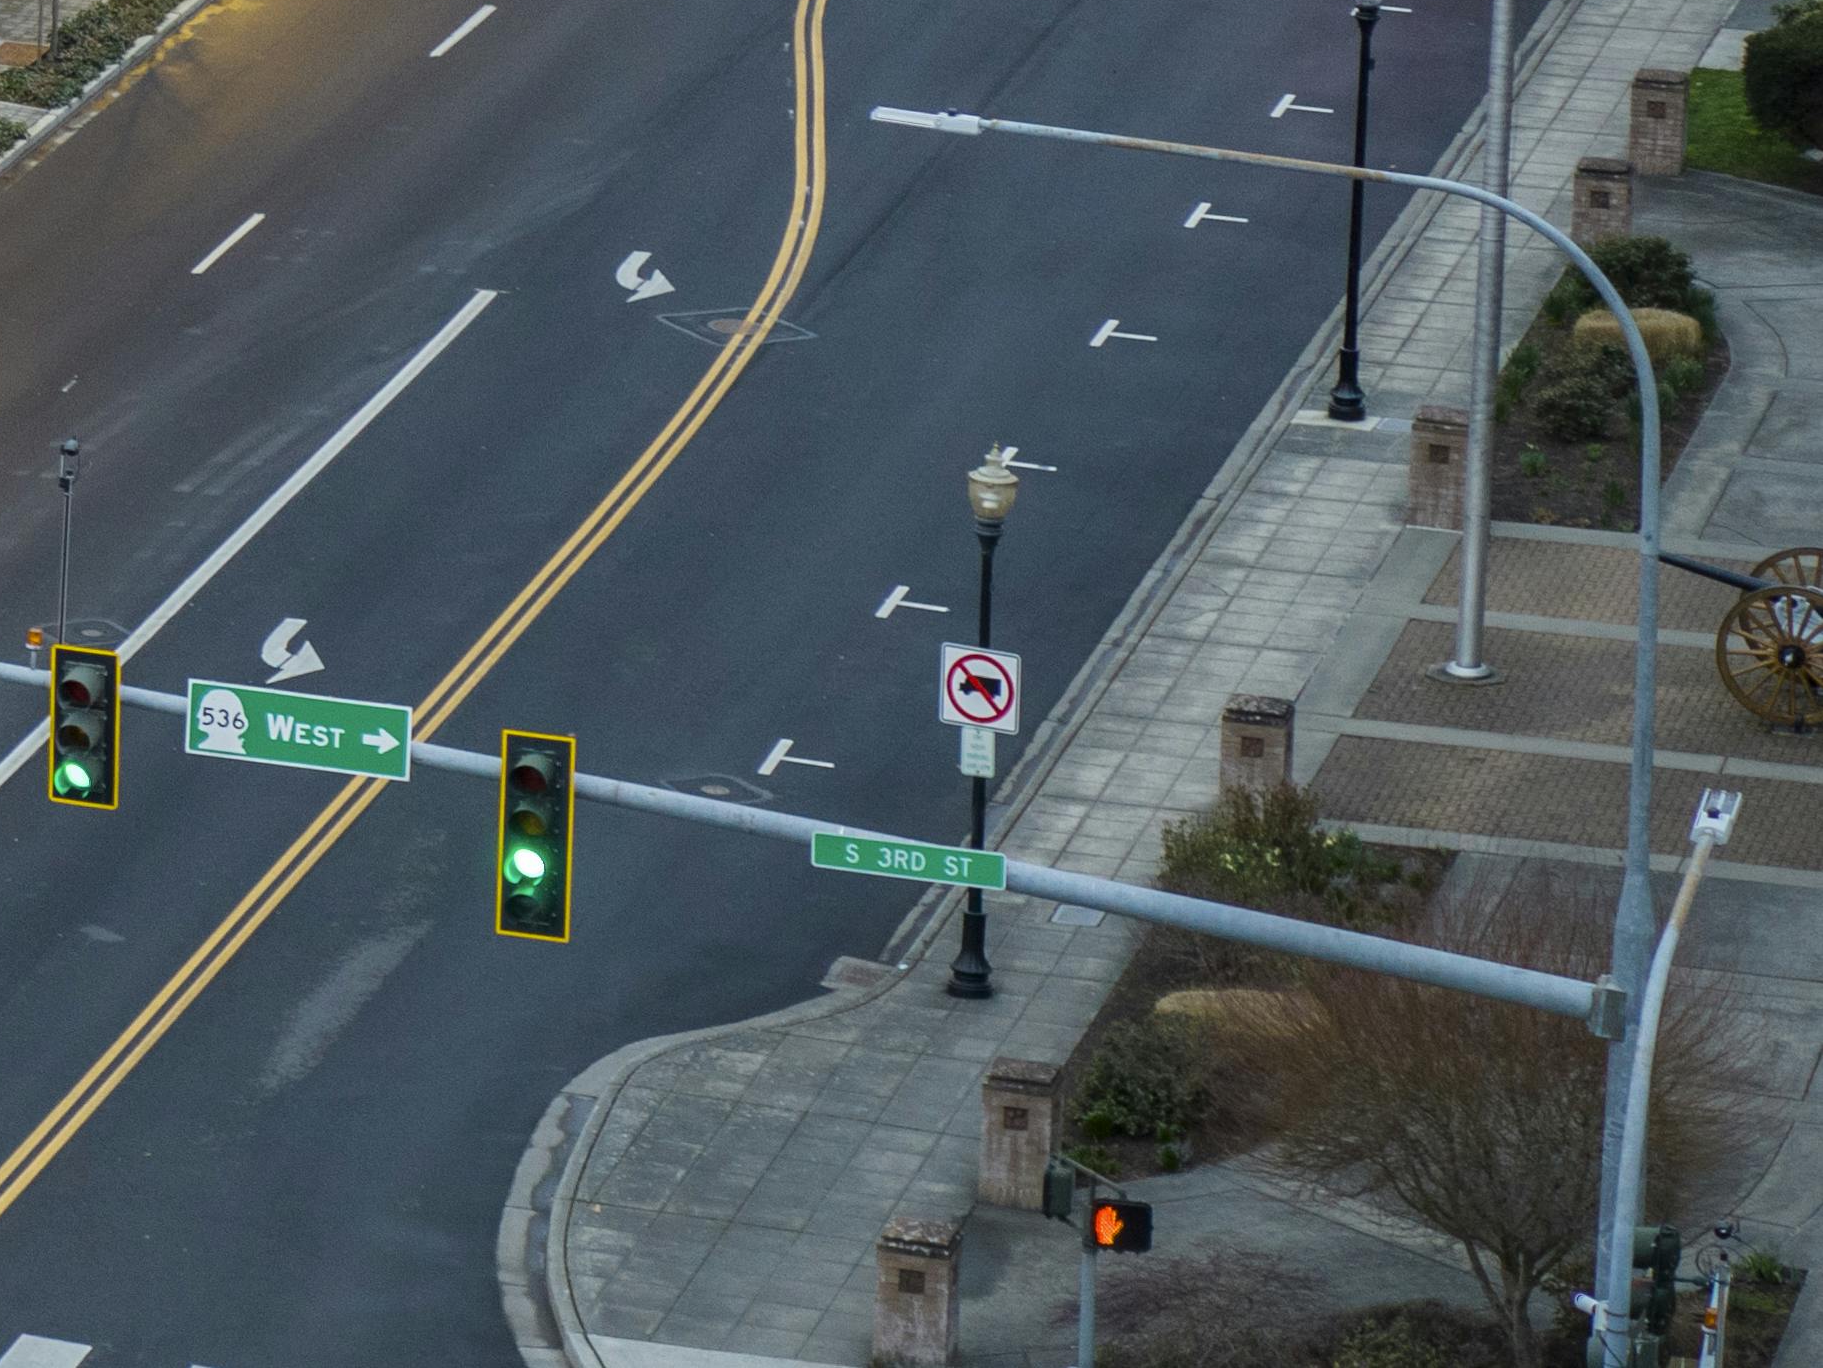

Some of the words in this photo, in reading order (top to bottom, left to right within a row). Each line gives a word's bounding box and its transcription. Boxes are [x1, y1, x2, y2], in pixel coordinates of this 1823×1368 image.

[202, 706, 246, 730] 536
[266, 712, 346, 749] WEST
[845, 843, 860, 865] S
[877, 846, 927, 873] 3RD
[944, 855, 974, 879] ST
